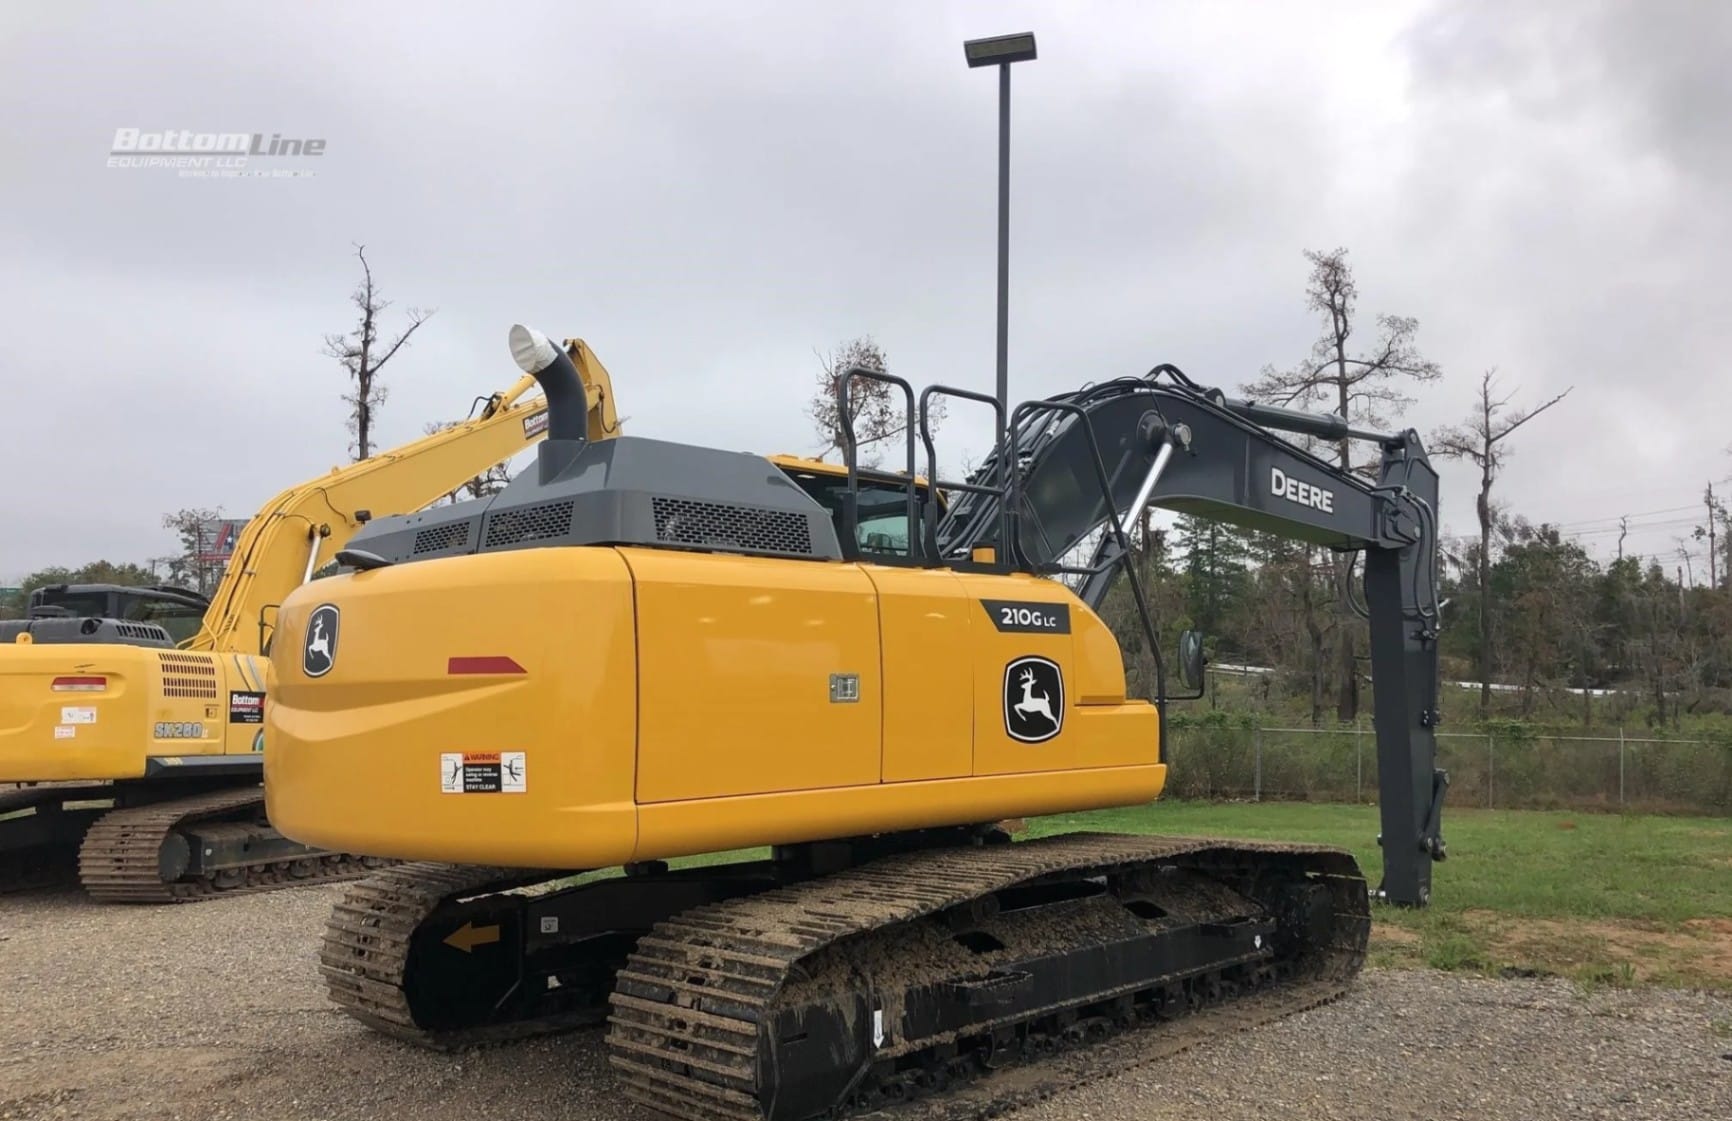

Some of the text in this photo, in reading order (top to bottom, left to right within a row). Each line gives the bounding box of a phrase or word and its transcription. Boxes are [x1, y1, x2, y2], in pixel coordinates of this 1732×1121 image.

[1271, 467, 1334, 514] DEERE
[1001, 608, 1056, 627] 210G LC
